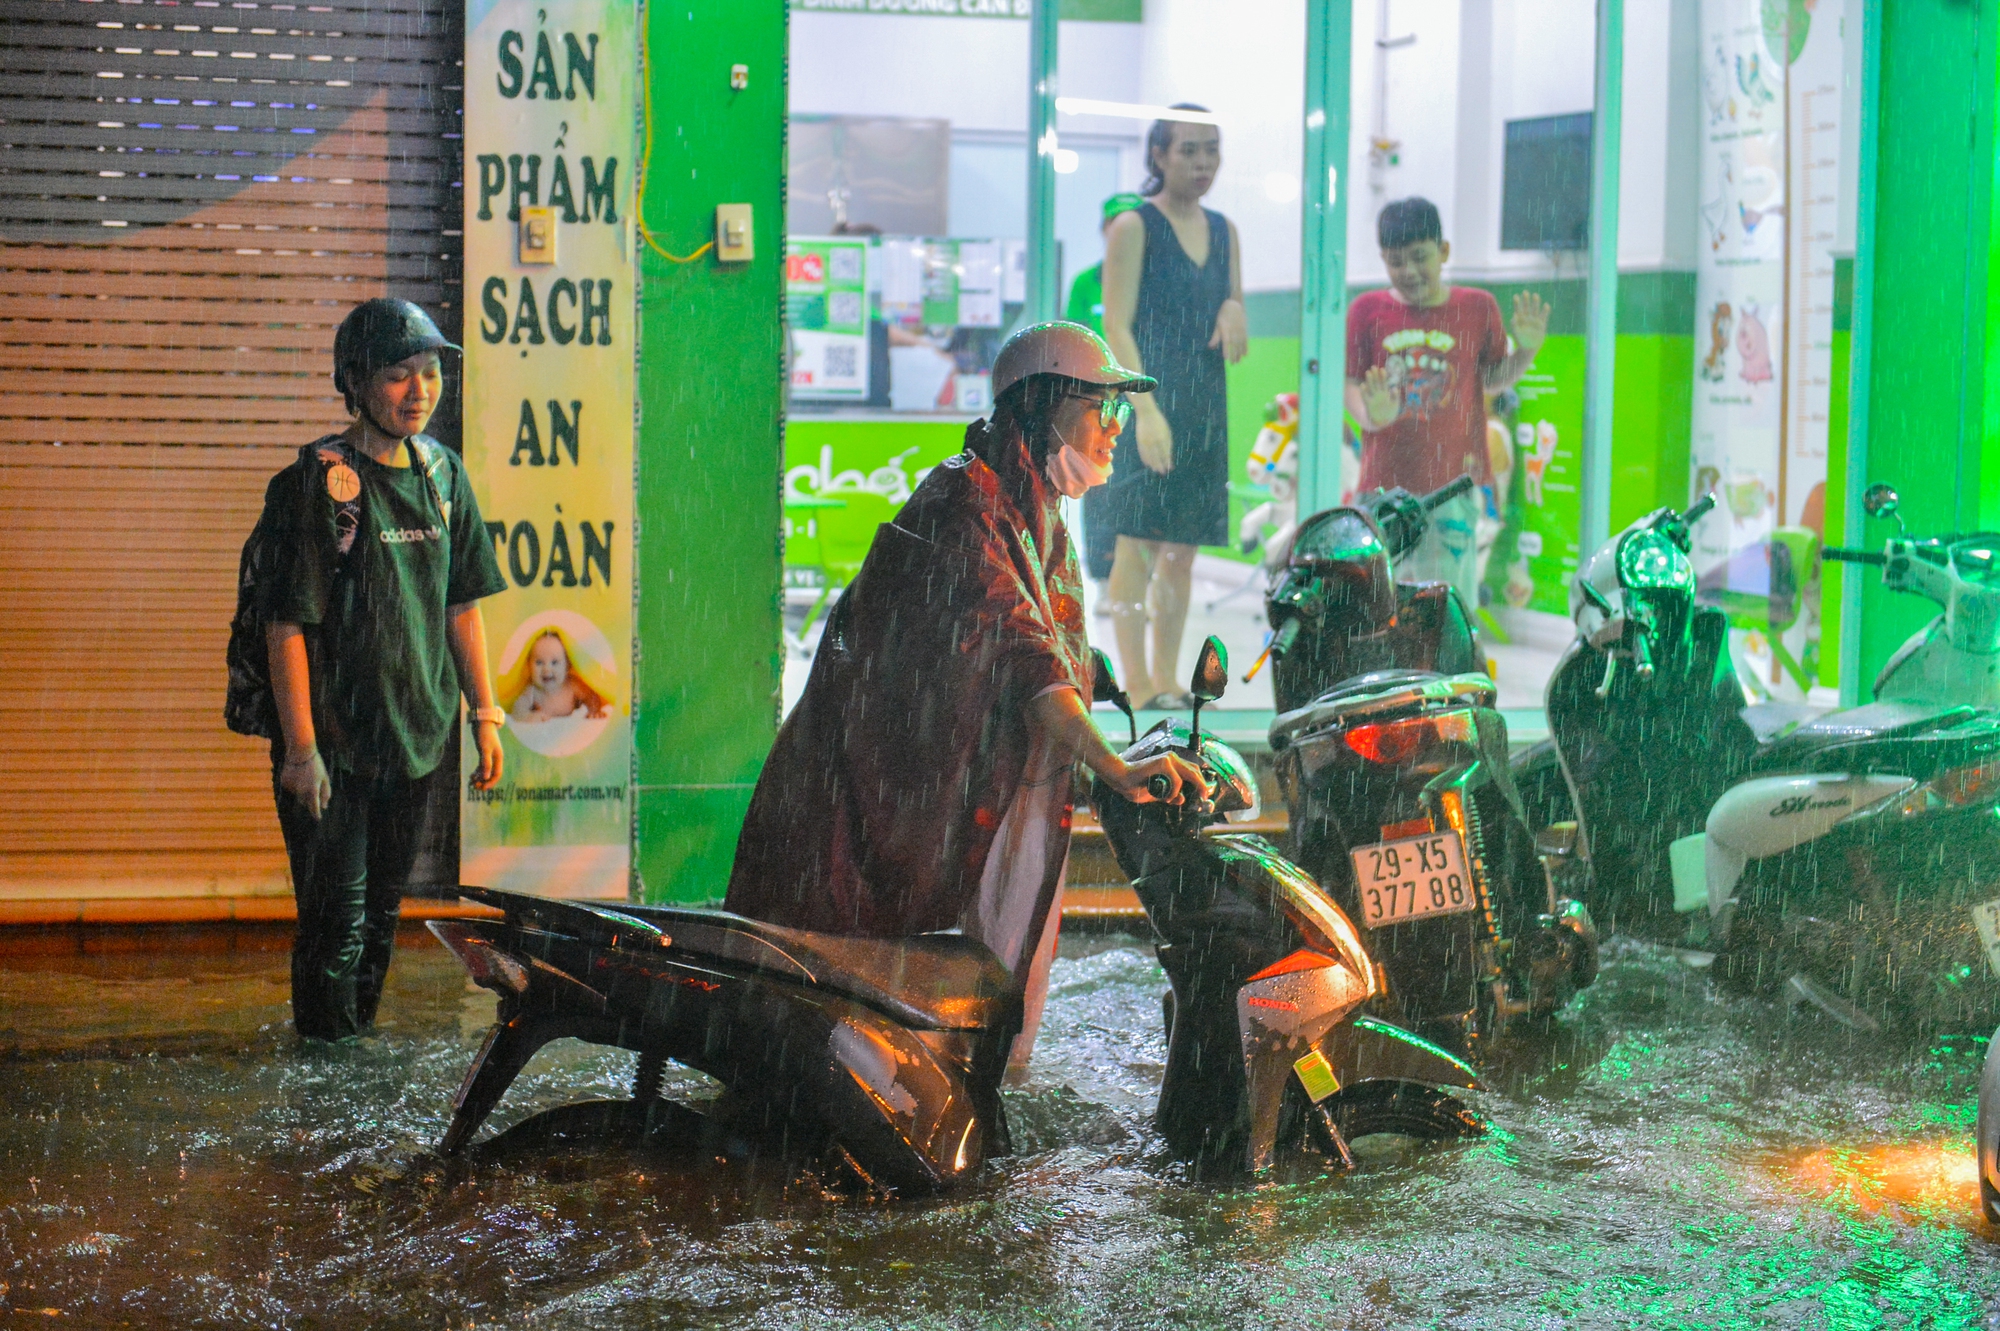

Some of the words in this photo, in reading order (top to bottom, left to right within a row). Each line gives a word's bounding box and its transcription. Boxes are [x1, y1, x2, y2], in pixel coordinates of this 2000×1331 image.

[496, 8, 599, 101] SẢN
[476, 121, 618, 225] PHẨM
[480, 276, 613, 358] SẠCH
[509, 397, 583, 467] AN
[1368, 838, 1448, 882] 29-X5
[1367, 873, 1465, 919] 377.88
[1248, 996, 1300, 1013] HONDA
